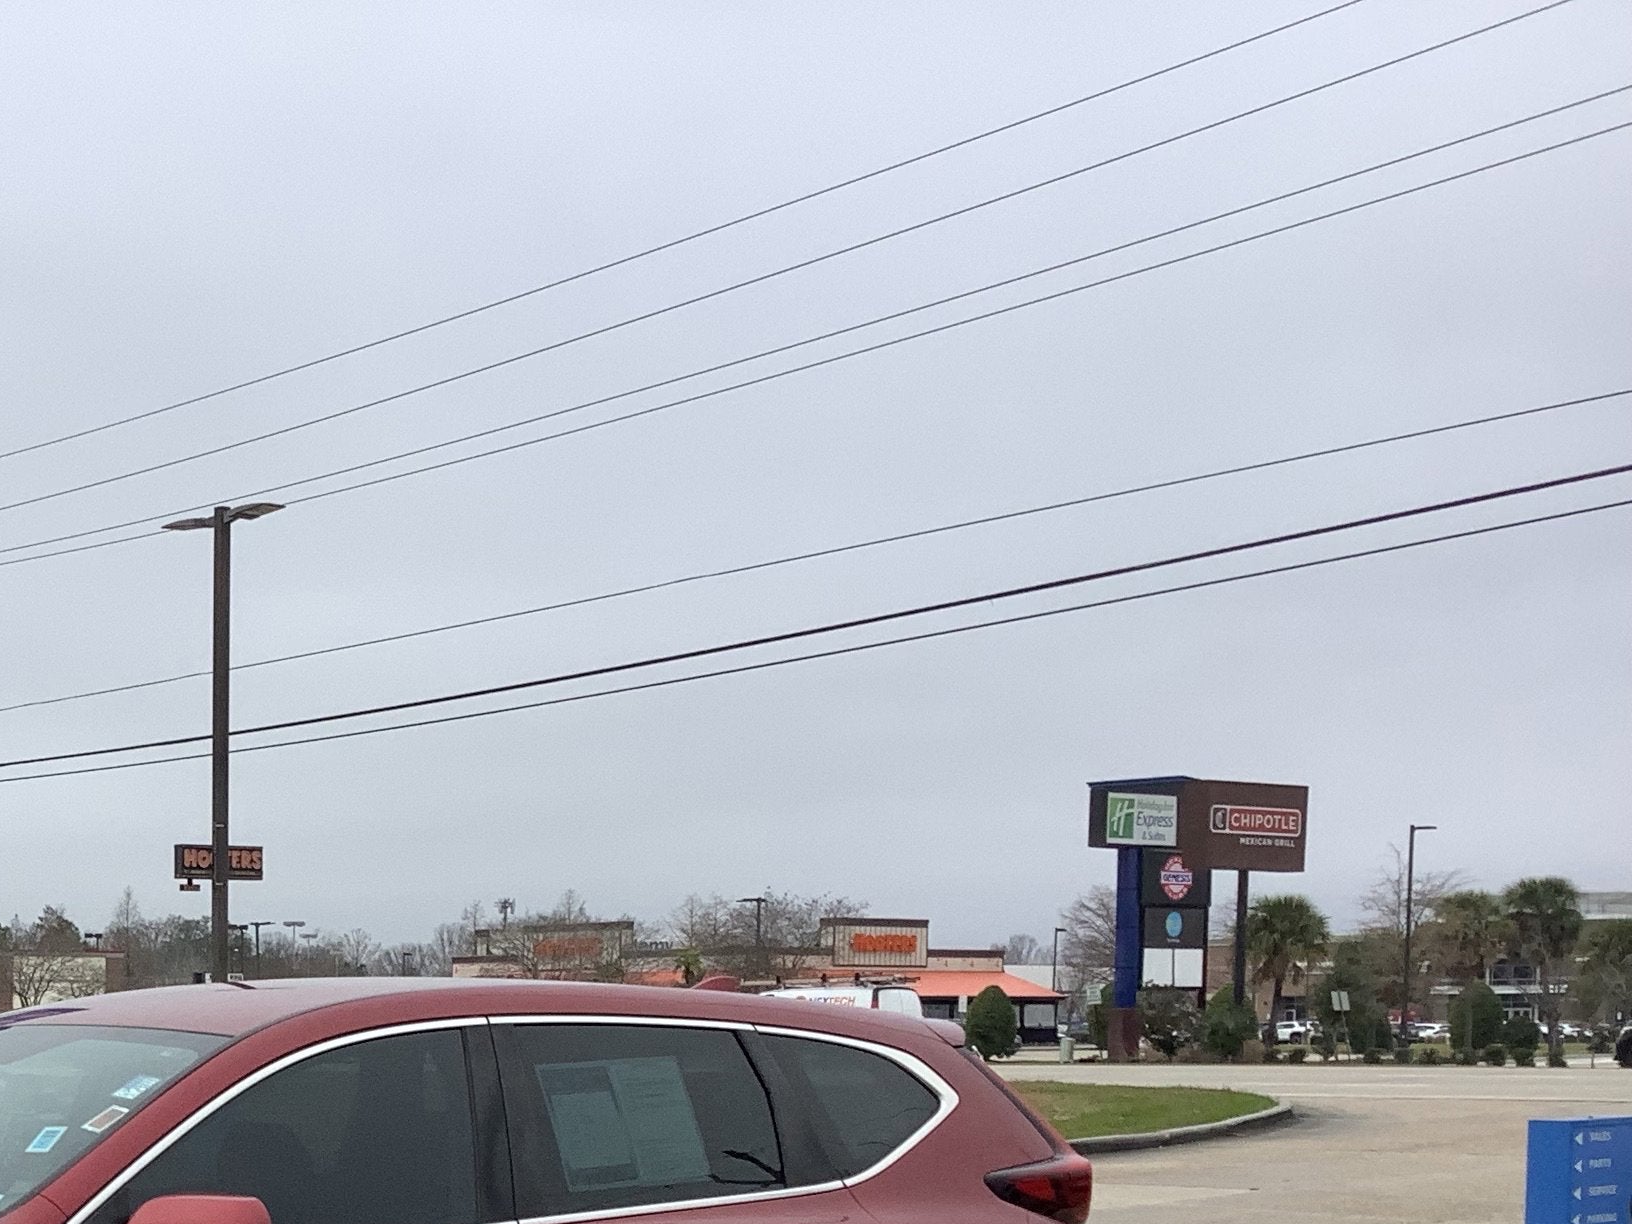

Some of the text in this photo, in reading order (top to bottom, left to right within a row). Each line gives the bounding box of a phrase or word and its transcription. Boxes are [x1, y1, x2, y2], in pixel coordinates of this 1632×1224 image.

[1137, 811, 1174, 829] Express
[1231, 812, 1297, 830] CHIPOTLE
[1239, 837, 1295, 848] MEXICAN GRILL
[183, 848, 261, 869] HOERS
[1162, 873, 1191, 883] GENESIS
